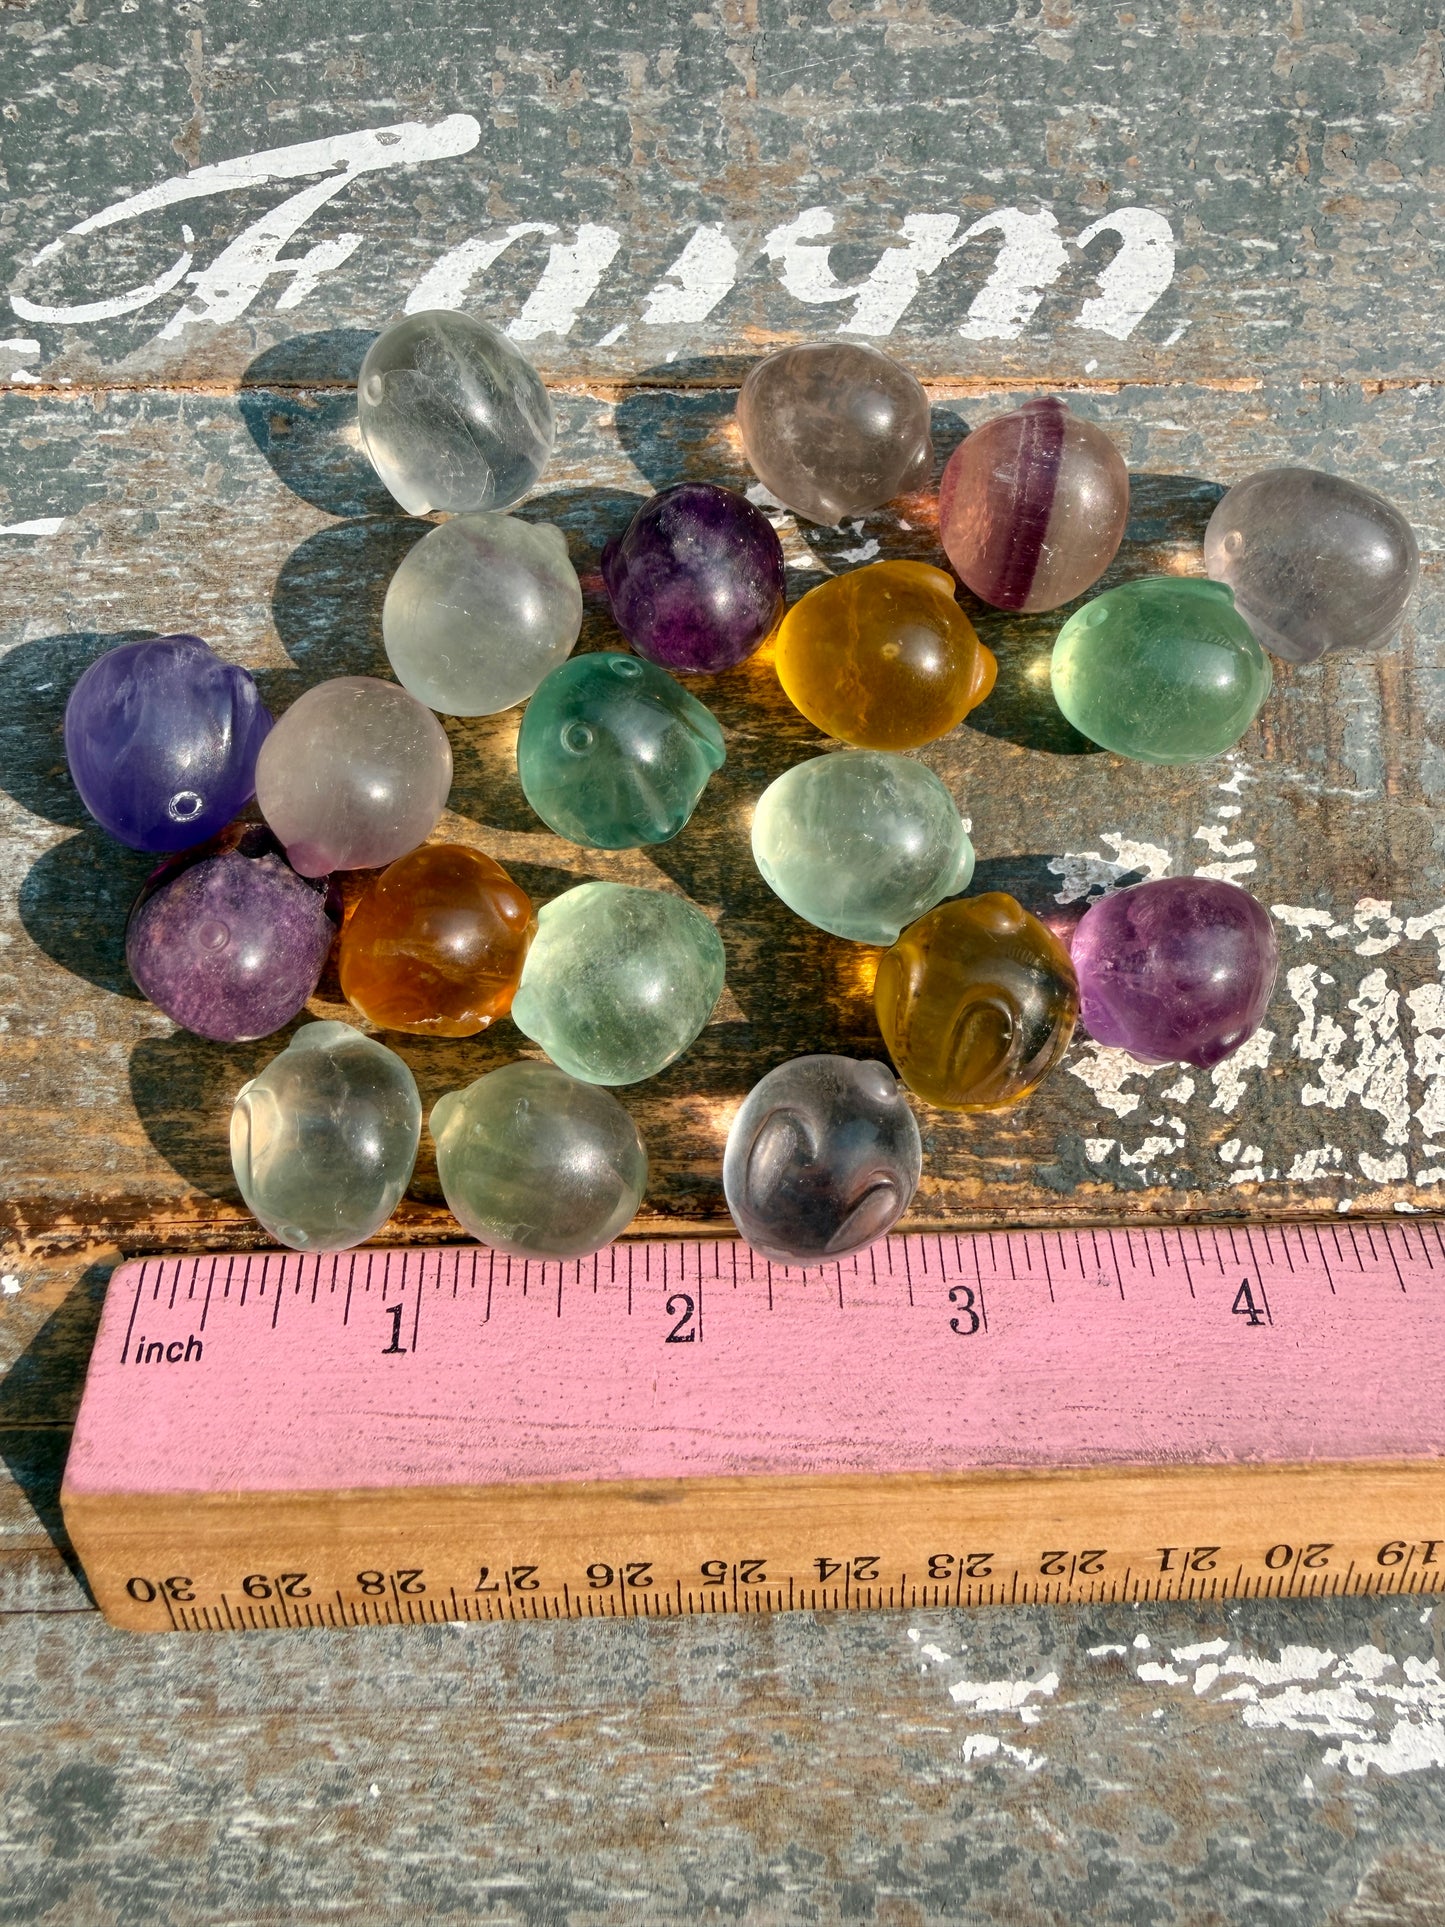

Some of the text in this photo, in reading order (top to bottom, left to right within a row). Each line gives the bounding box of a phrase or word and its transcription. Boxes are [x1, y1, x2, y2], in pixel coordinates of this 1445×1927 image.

[381, 1277, 1266, 1355] 1 2 3 4
[134, 1334, 204, 1365] inch
[927, 1553, 995, 1579] 23
[1039, 1549, 1109, 1576] 22
[1156, 1546, 1222, 1572] 21
[1264, 1543, 1335, 1569] 20
[355, 1569, 427, 1595] 28
[474, 1565, 541, 1592] 27
[586, 1562, 654, 1588] 26
[700, 1559, 768, 1585] 25
[813, 1556, 881, 1583] 24
[125, 1576, 196, 1602] 30
[242, 1573, 313, 1600] 29
